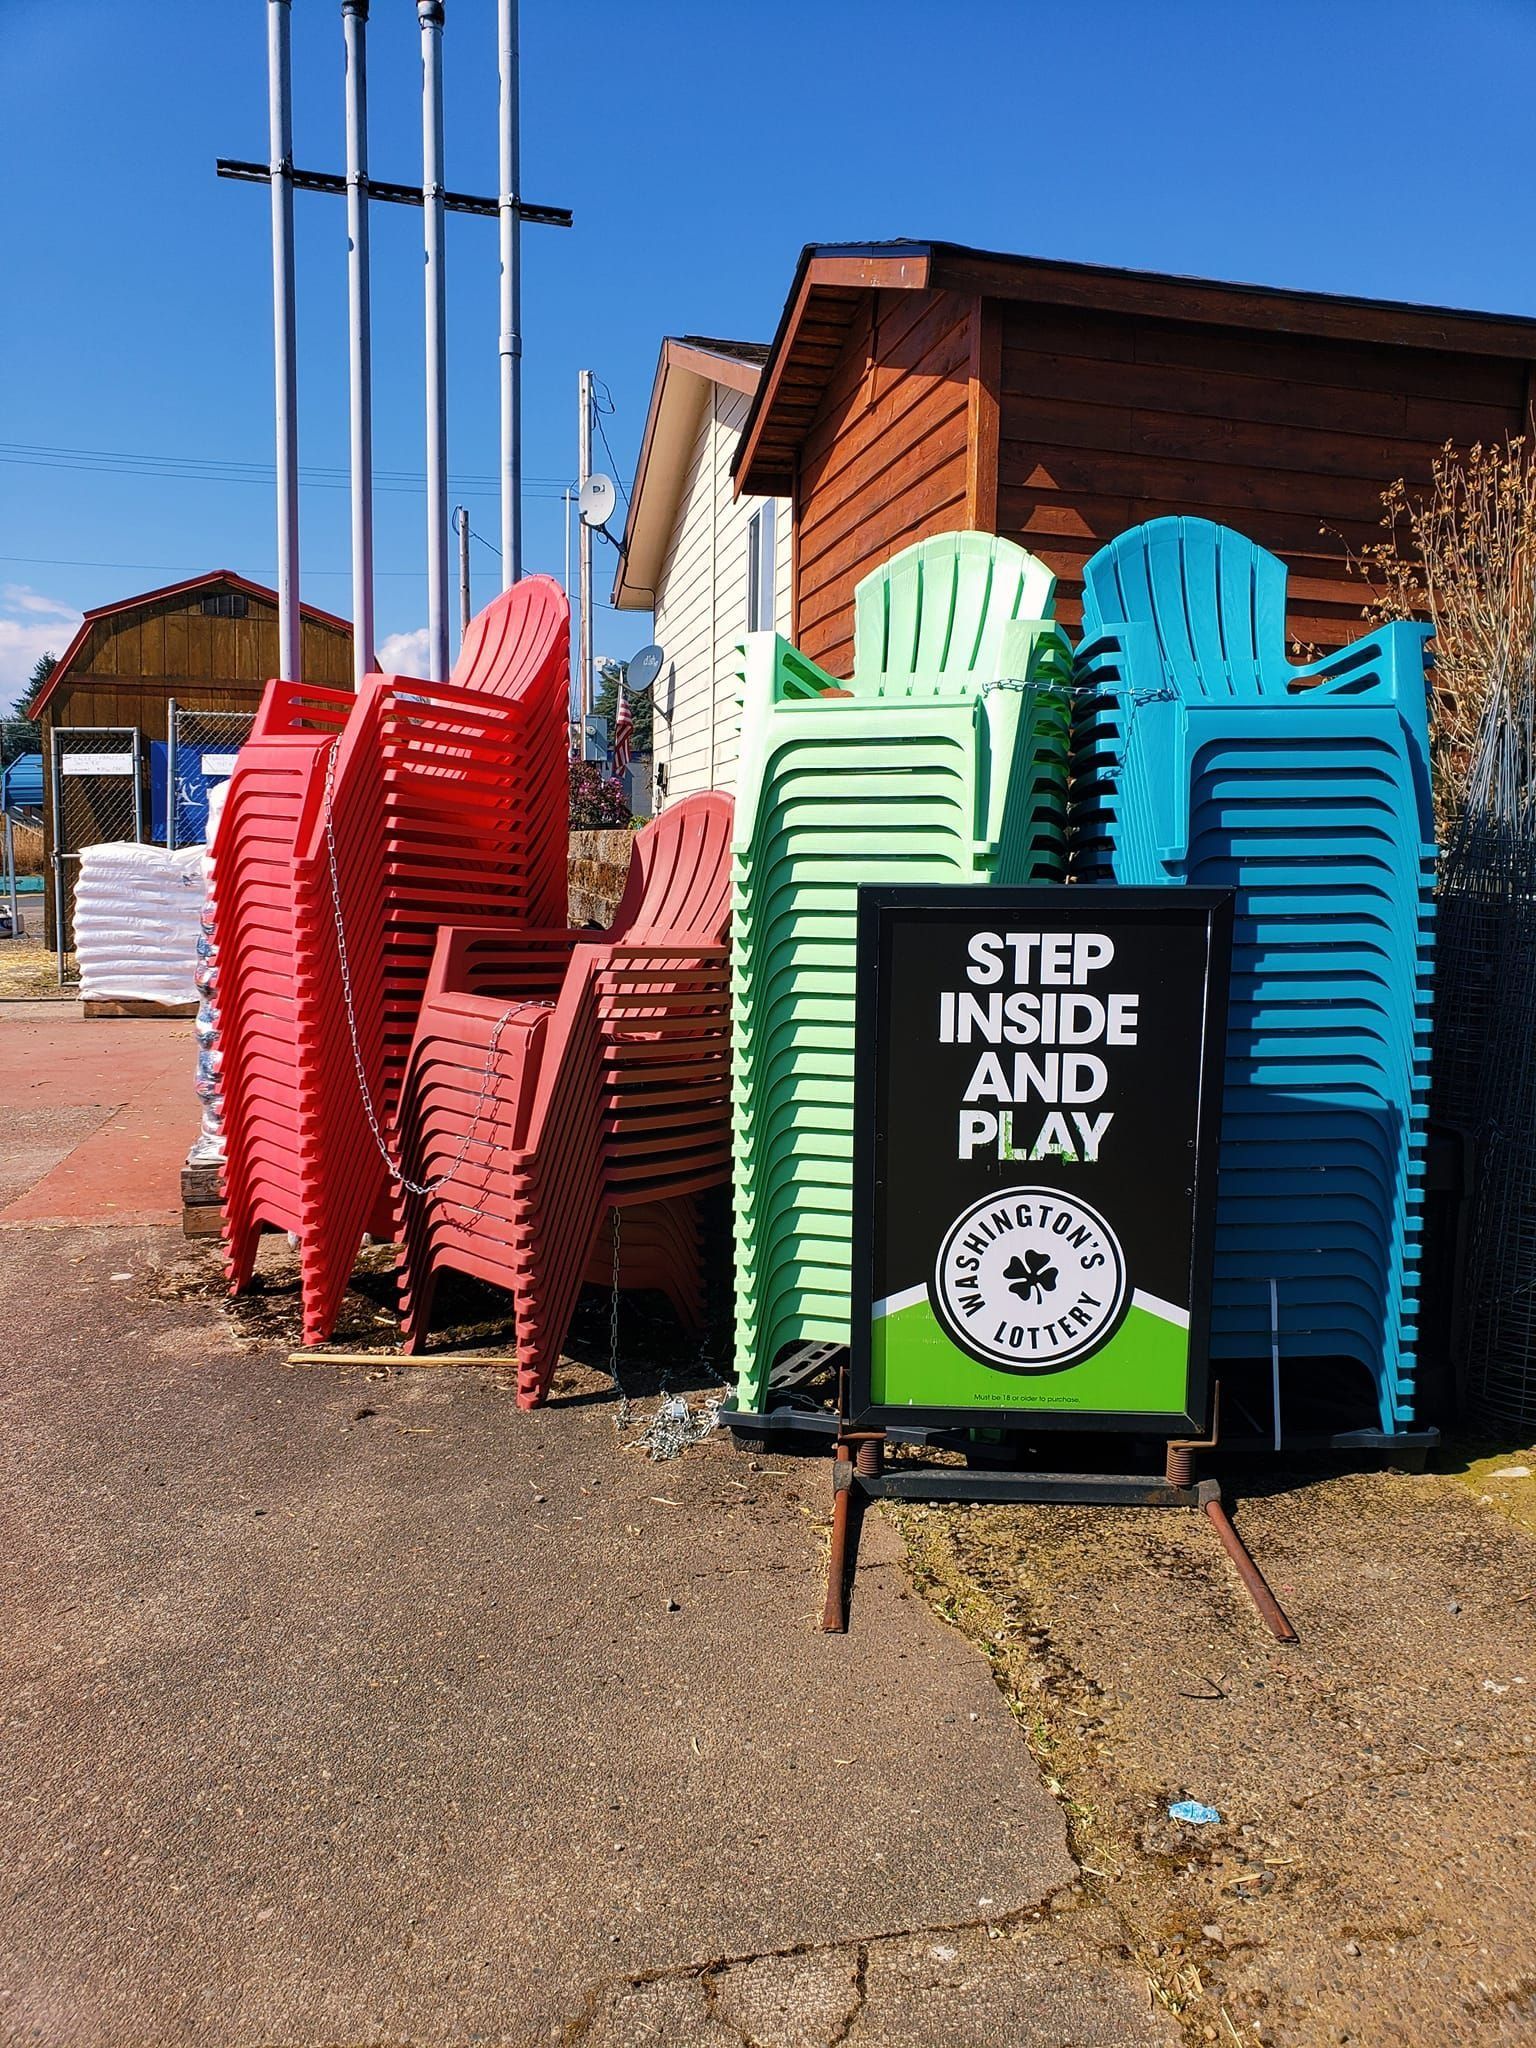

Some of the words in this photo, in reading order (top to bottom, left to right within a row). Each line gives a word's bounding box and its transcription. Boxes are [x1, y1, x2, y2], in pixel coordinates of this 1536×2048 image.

[966, 931, 1115, 985] STEP
[939, 991, 1139, 1045] INSIDE
[962, 1051, 1108, 1103] AND
[958, 1109, 1115, 1163] PLAY
[954, 1203, 1105, 1318] WASHINGTON'S
[993, 1290, 1102, 1350] LOTTERY
